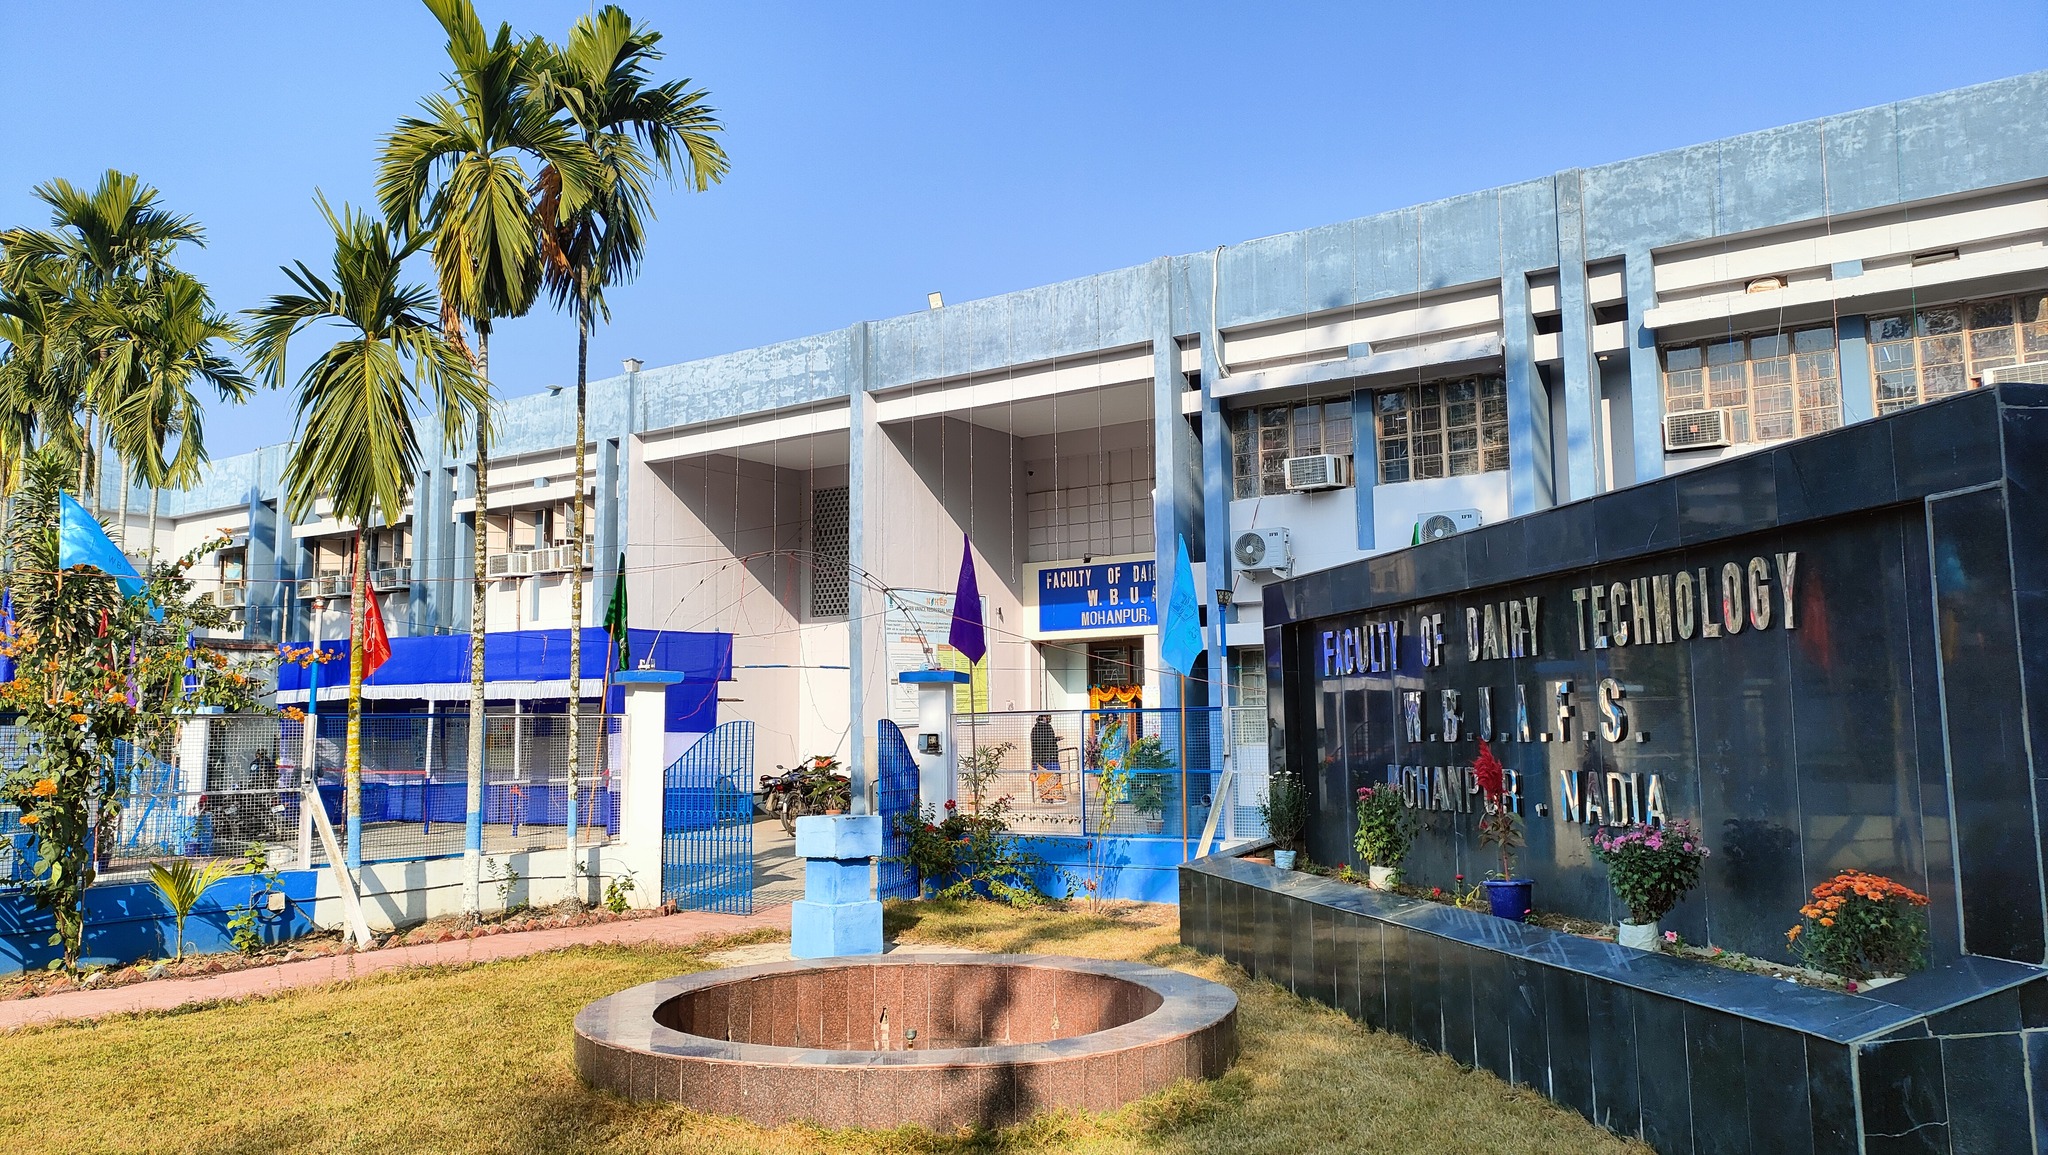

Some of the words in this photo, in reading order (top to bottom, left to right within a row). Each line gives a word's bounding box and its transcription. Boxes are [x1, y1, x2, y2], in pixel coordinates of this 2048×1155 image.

[1046, 569, 1091, 589] FACULTY
[1108, 566, 1120, 584] OF
[1322, 620, 1401, 677] FACULTY
[1420, 612, 1445, 667] OF
[1466, 596, 1540, 662] DAIRY
[1572, 551, 1798, 651] TECHNOLOGY
[1560, 769, 1666, 829] NADIA
